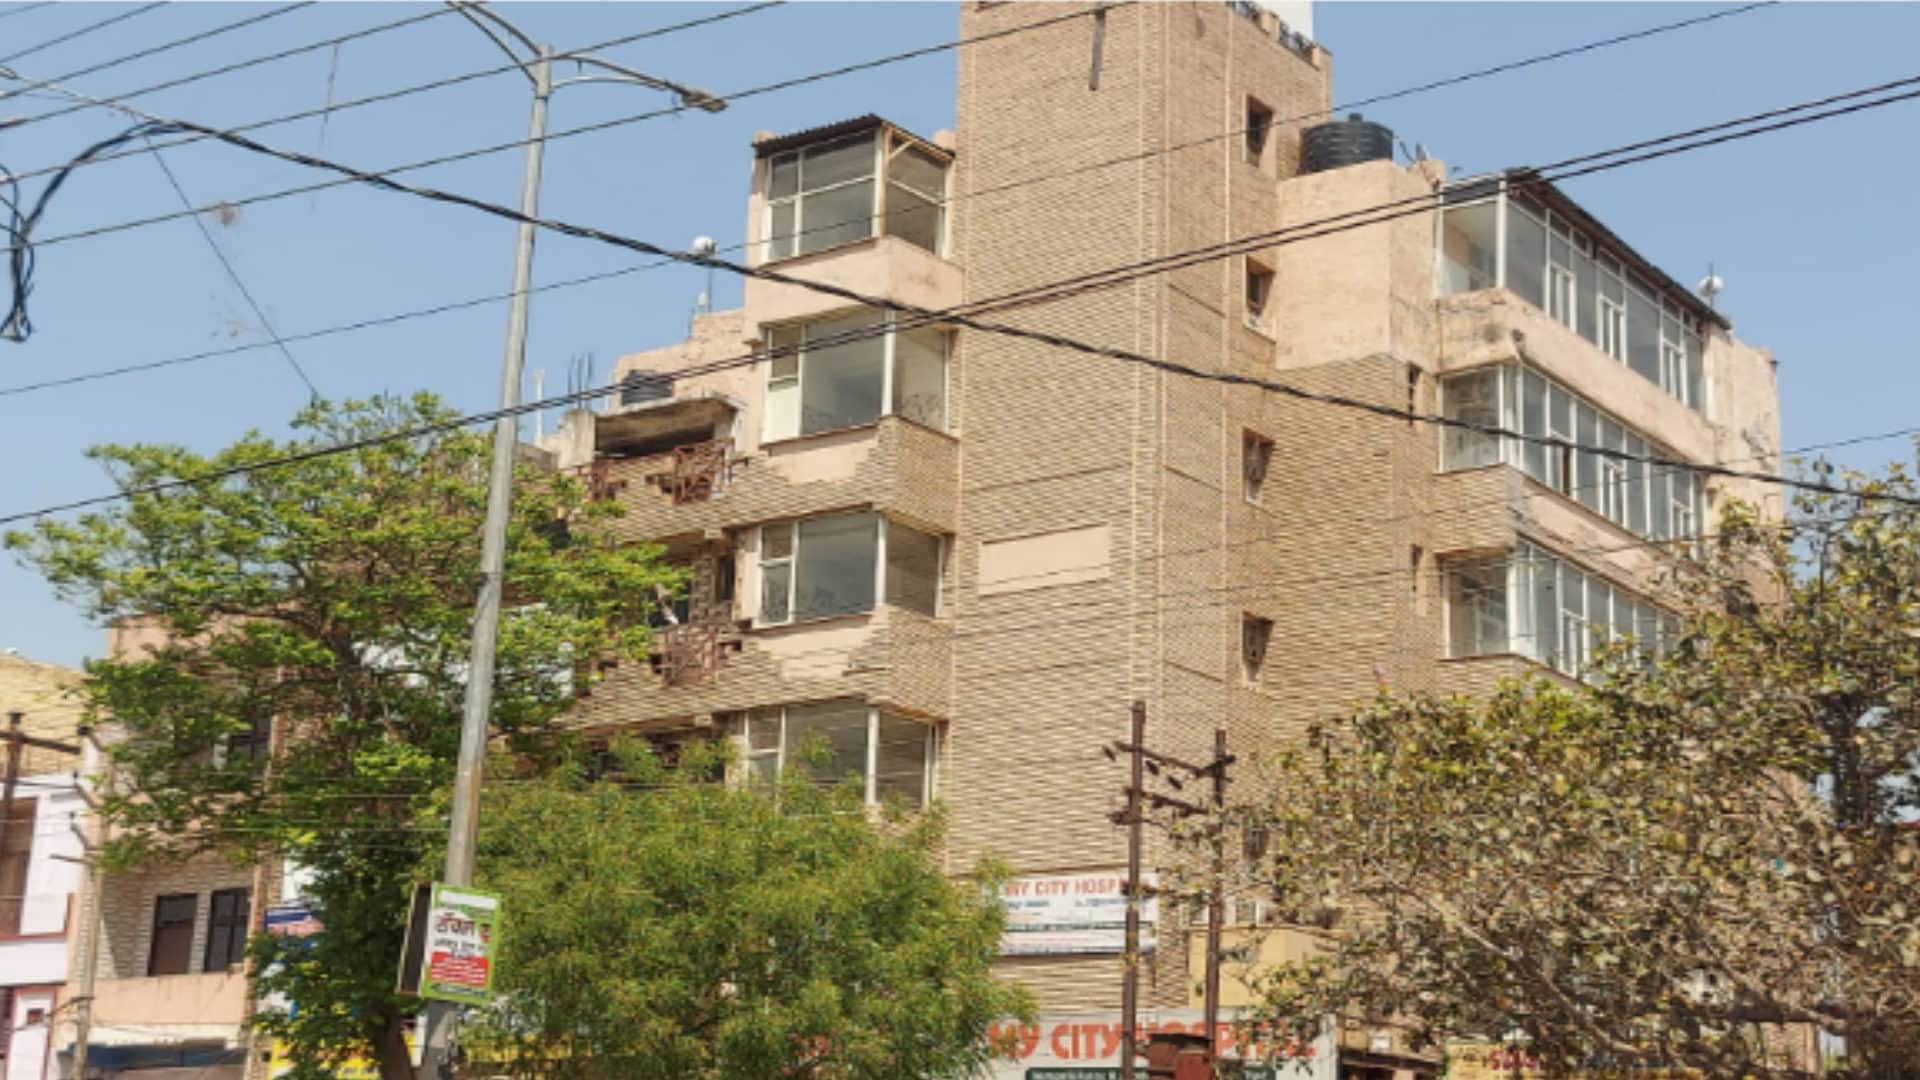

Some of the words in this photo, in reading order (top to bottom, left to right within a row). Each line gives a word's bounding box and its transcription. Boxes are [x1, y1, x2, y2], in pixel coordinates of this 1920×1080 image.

[1005, 881, 1029, 897] MY
[1035, 880, 1071, 896] CITY
[986, 1023, 1041, 1060] MY
[1051, 1023, 1125, 1060] CITY
